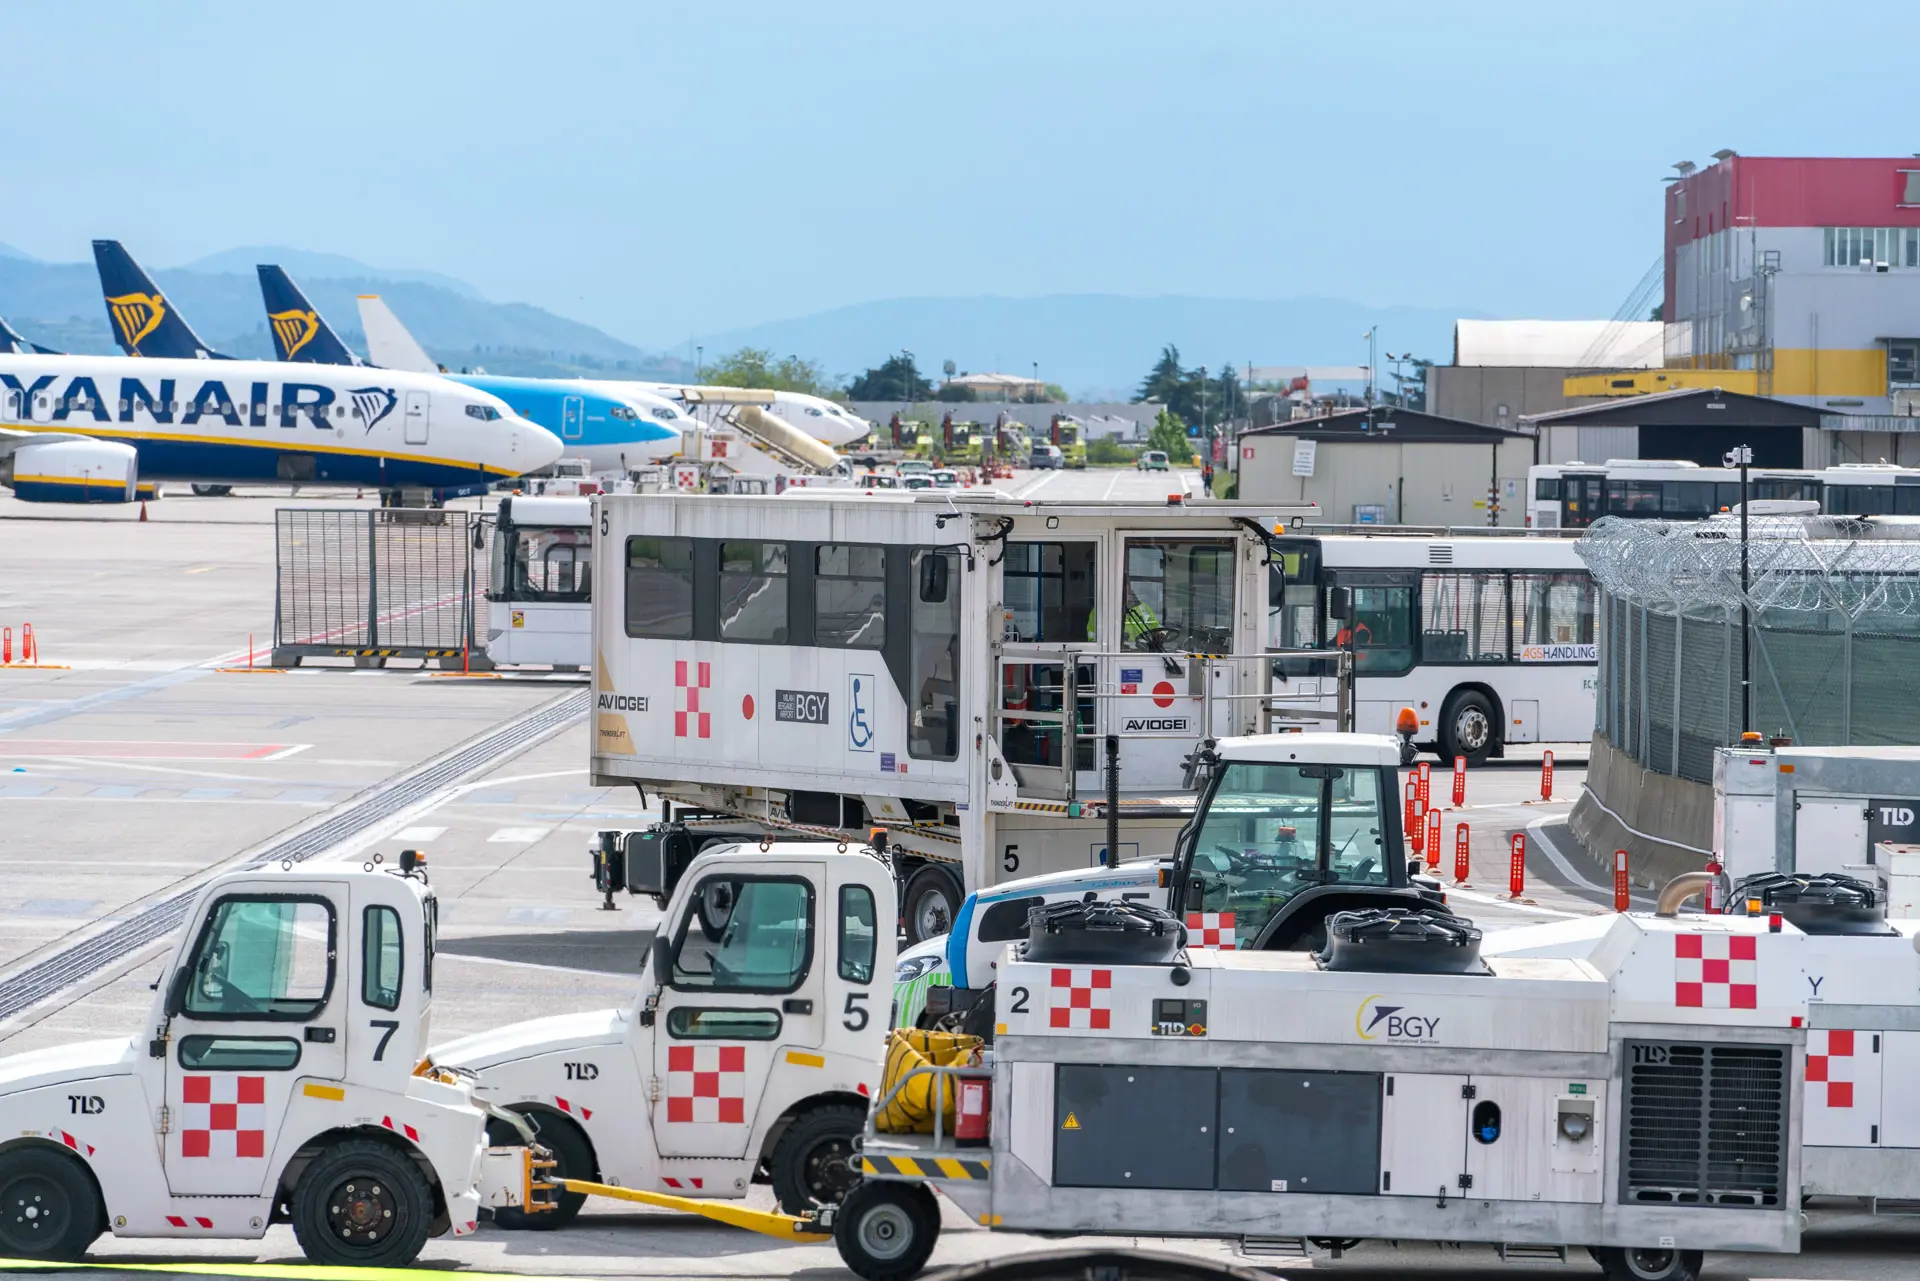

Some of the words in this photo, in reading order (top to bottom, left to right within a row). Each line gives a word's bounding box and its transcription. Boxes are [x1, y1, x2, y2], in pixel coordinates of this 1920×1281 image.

[600, 509, 609, 537] 5
[1522, 645, 1596, 660] AGSHANDLING
[597, 693, 649, 712] AVIOGEI
[796, 694, 827, 721] BGY
[1125, 719, 1186, 731] AVIOGEI
[1880, 807, 1914, 826] TLD
[1004, 844, 1020, 873] 5
[1011, 987, 1030, 1014] 2
[843, 992, 869, 1032] 5
[1158, 1021, 1186, 1035] TLD
[1388, 1015, 1441, 1037] BGY
[370, 1020, 400, 1061] 7
[1631, 1044, 1667, 1063] TLD
[563, 1062, 599, 1081] TLD
[68, 1095, 105, 1115] TLD
